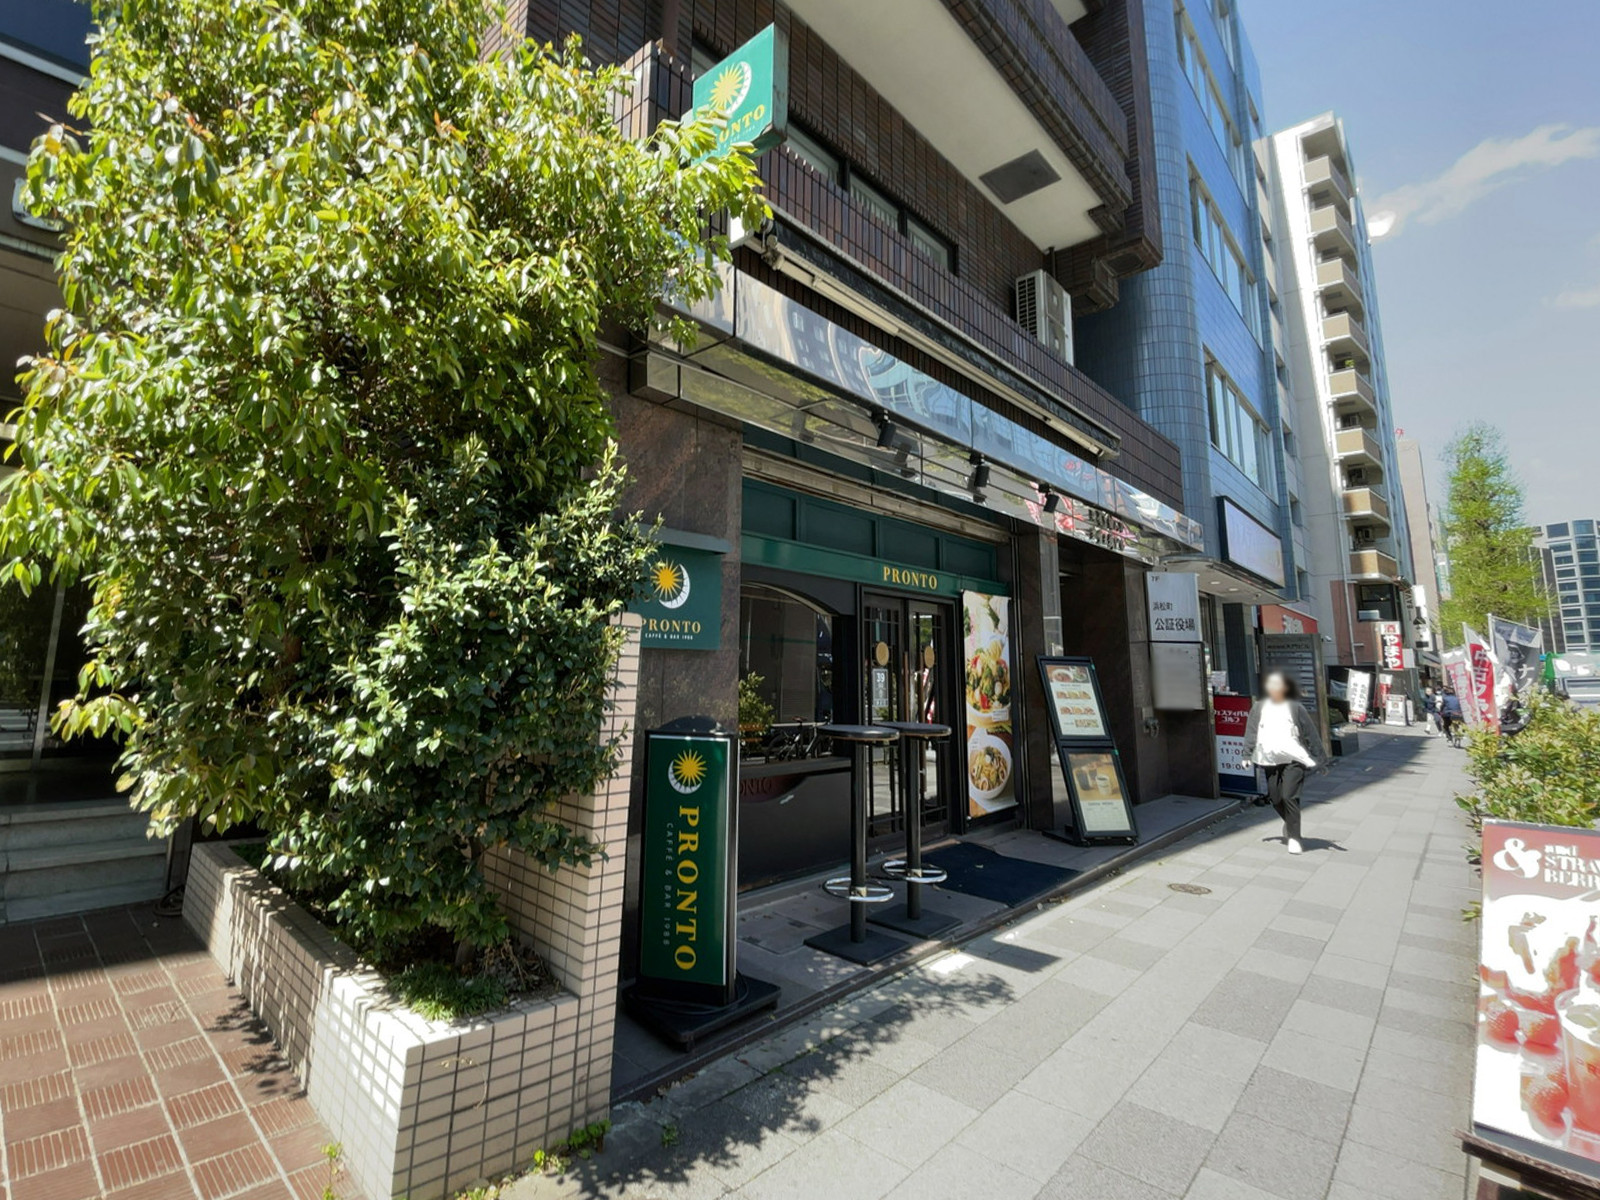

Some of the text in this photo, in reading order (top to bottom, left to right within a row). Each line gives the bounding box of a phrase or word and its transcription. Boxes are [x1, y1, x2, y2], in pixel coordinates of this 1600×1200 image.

[883, 566, 938, 590] PRONTO
[1153, 601, 1173, 611] 浜松町
[641, 618, 701, 633] PRONTO
[1155, 617, 1196, 631] 公証役場
[1384, 634, 1402, 669] やまや
[674, 805, 700, 970] PRONTO
